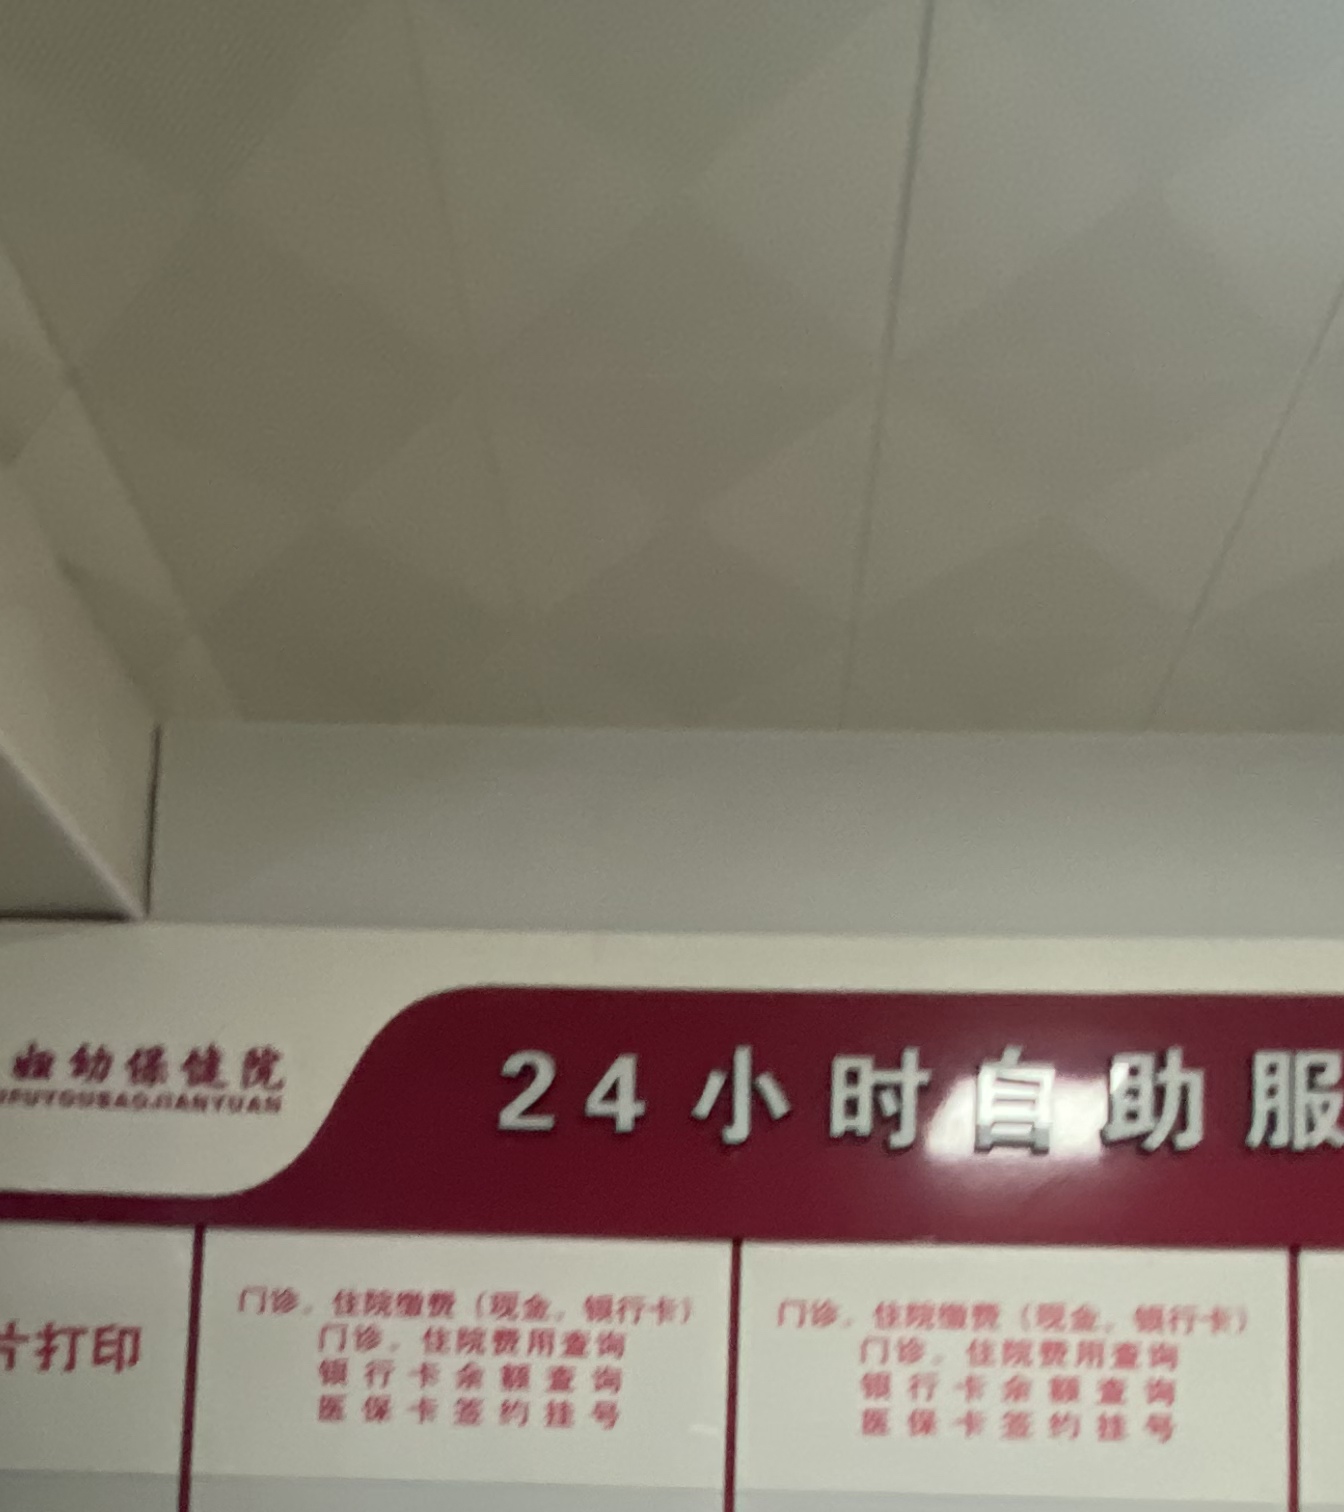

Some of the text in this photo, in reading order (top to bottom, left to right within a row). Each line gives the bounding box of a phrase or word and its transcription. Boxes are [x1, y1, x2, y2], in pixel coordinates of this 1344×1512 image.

[317, 1357, 623, 1395] 银行卡余额查询
[860, 1371, 1177, 1408] 银行卡余额查询
[317, 1393, 620, 1431] 医保卡签约挂号
[860, 1407, 1175, 1445] 医保卡签约挂号
